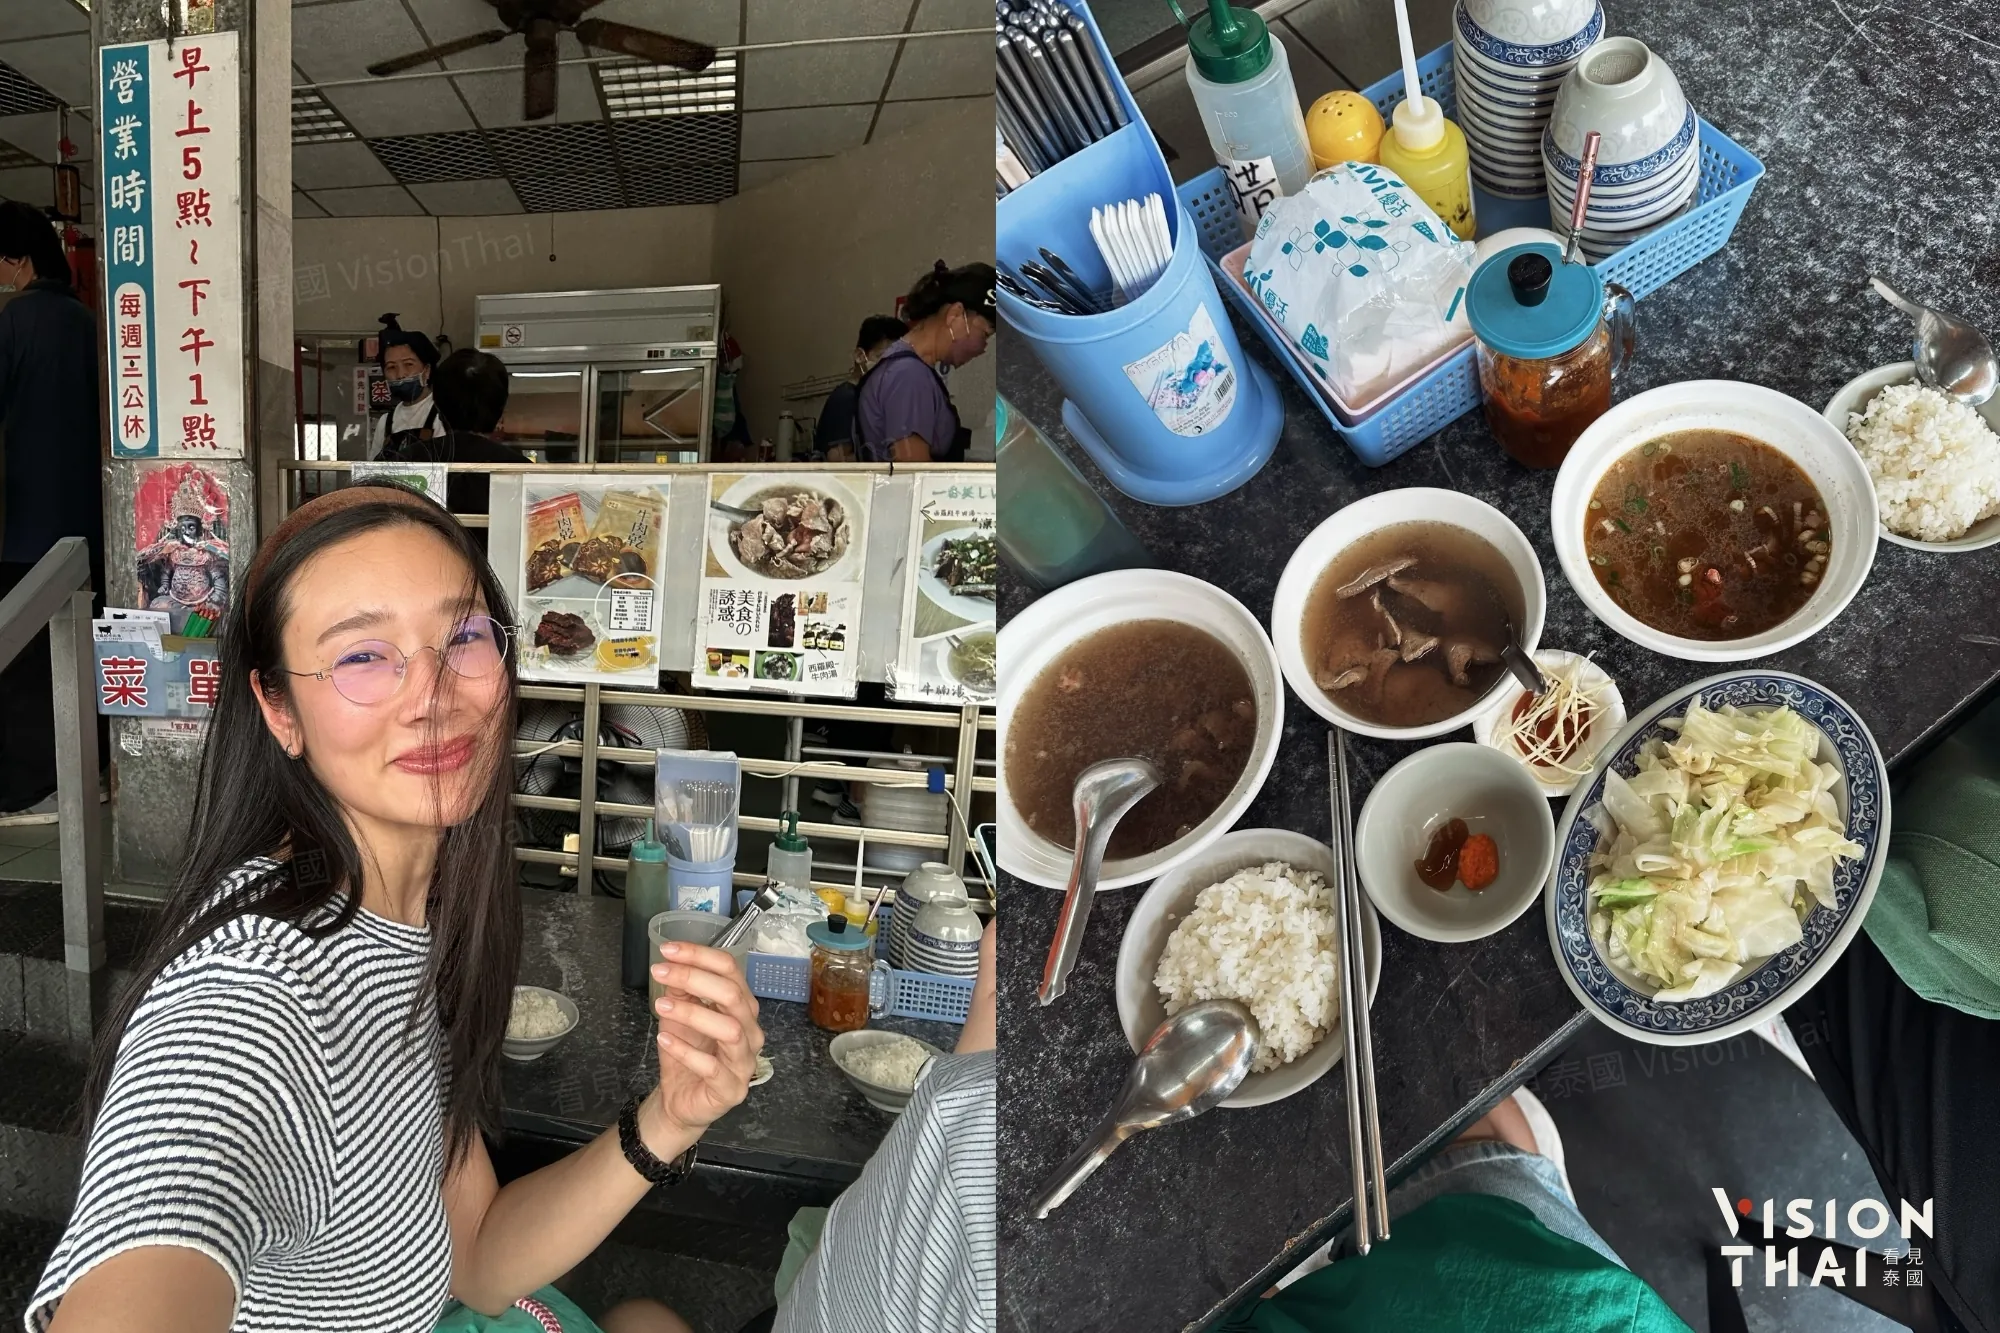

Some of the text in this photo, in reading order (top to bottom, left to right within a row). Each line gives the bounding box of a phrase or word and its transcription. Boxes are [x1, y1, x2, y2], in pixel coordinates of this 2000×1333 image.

[109, 58, 147, 267] 營業時間
[1377, 191, 1412, 218] 優活
[119, 292, 146, 439] 每週三公休
[626, 509, 652, 551] 牛肉乾
[735, 589, 755, 636] 美食の
[100, 655, 222, 710] 菜單
[811, 669, 838, 682] 牛肉湯
[920, 681, 965, 698] 牛腩湯
